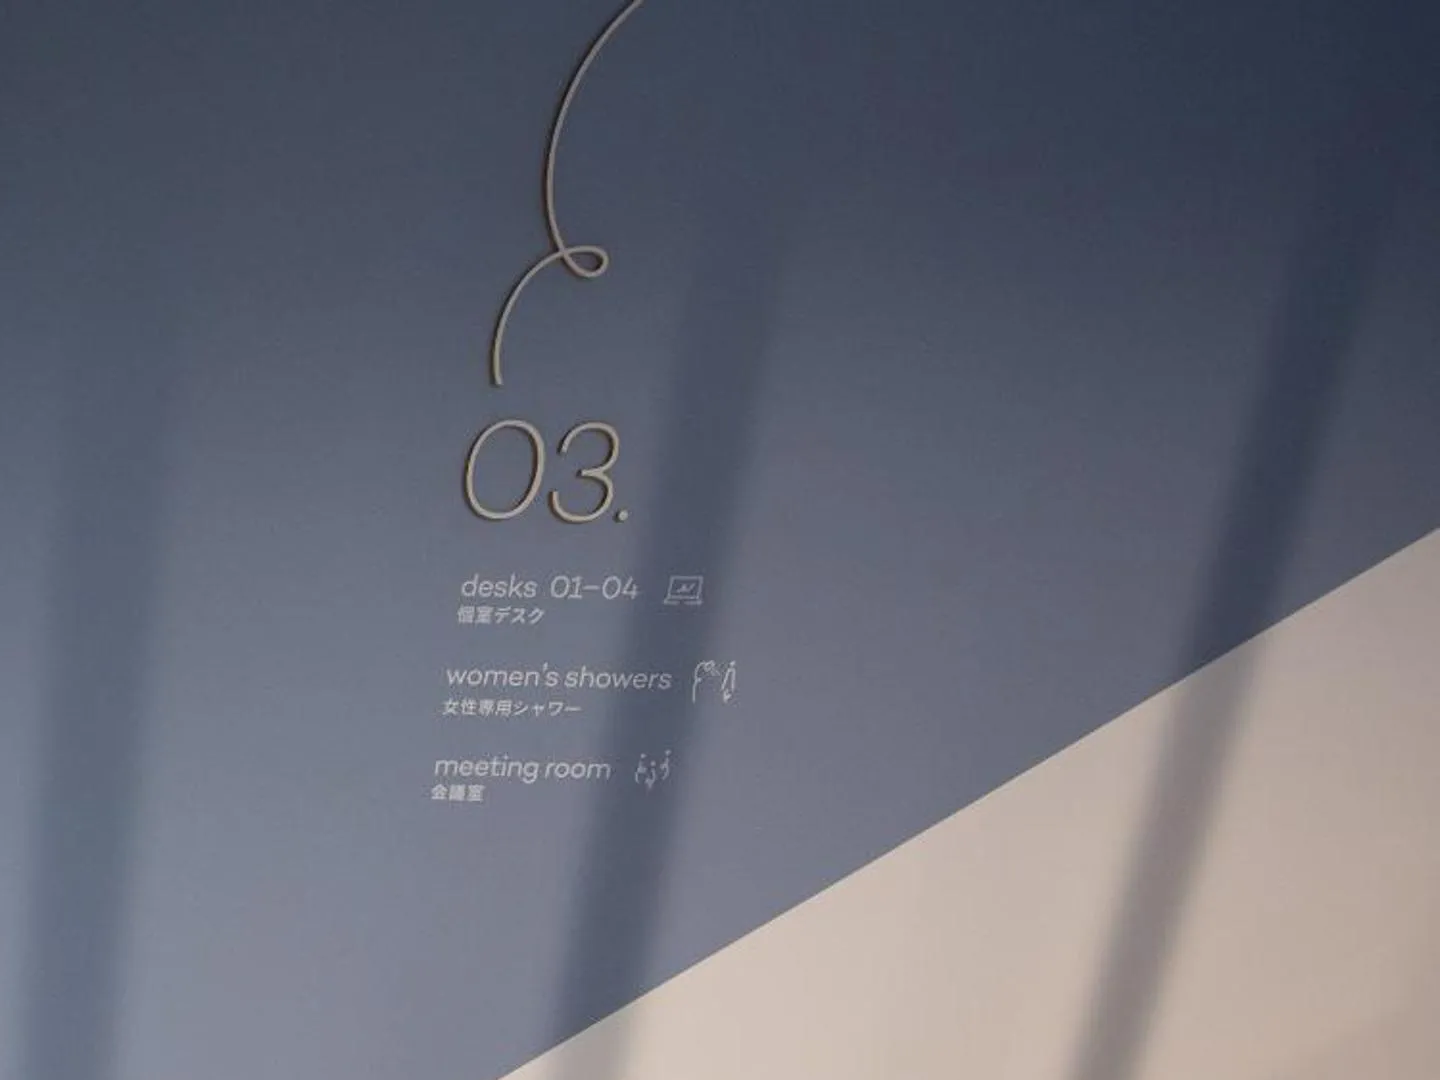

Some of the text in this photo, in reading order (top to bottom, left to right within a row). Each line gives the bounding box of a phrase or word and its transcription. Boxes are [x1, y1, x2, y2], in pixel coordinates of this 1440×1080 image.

[464, 419, 630, 524] 03.
[461, 574, 538, 598] desks
[457, 606, 545, 625] 個室デスク
[446, 663, 672, 691] women's showers
[442, 700, 583, 718] 女性専用シャワー
[434, 754, 612, 784] meeting room
[430, 784, 486, 802] 会議室
